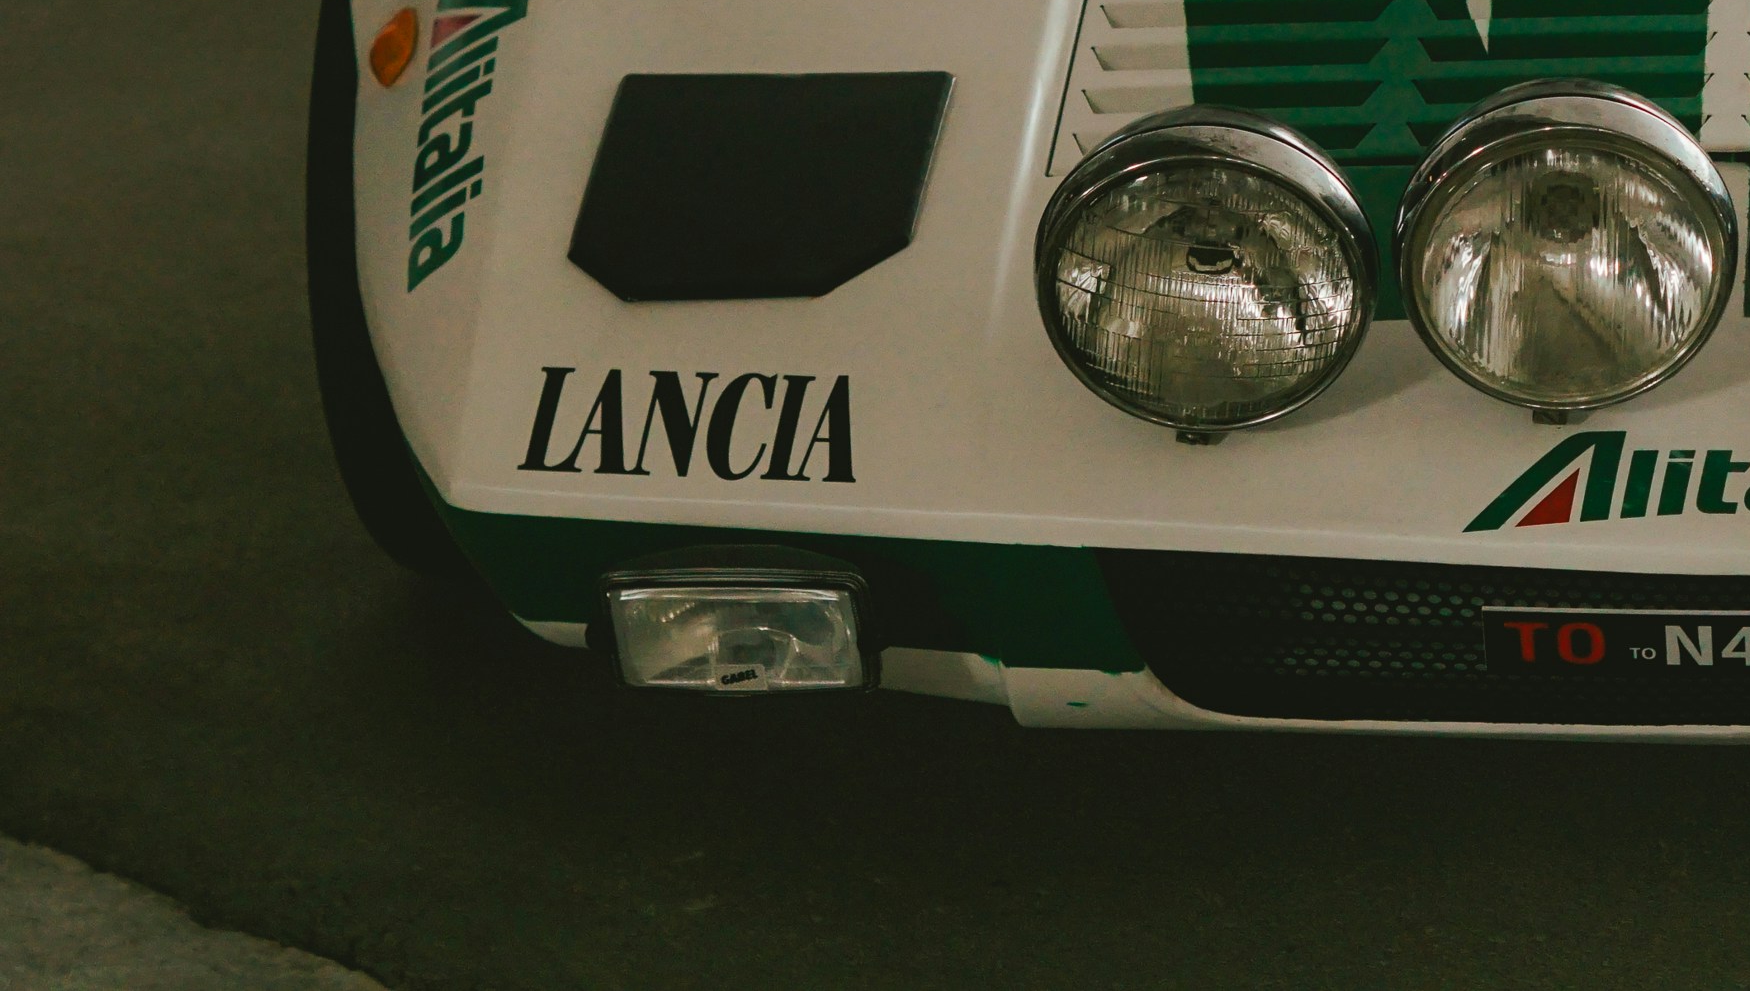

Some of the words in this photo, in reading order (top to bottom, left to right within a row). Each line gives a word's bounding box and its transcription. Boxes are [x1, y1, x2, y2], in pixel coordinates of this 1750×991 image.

[516, 365, 857, 484] LANCIA
[1503, 621, 1607, 666] TO
[1630, 647, 1657, 660] TO
